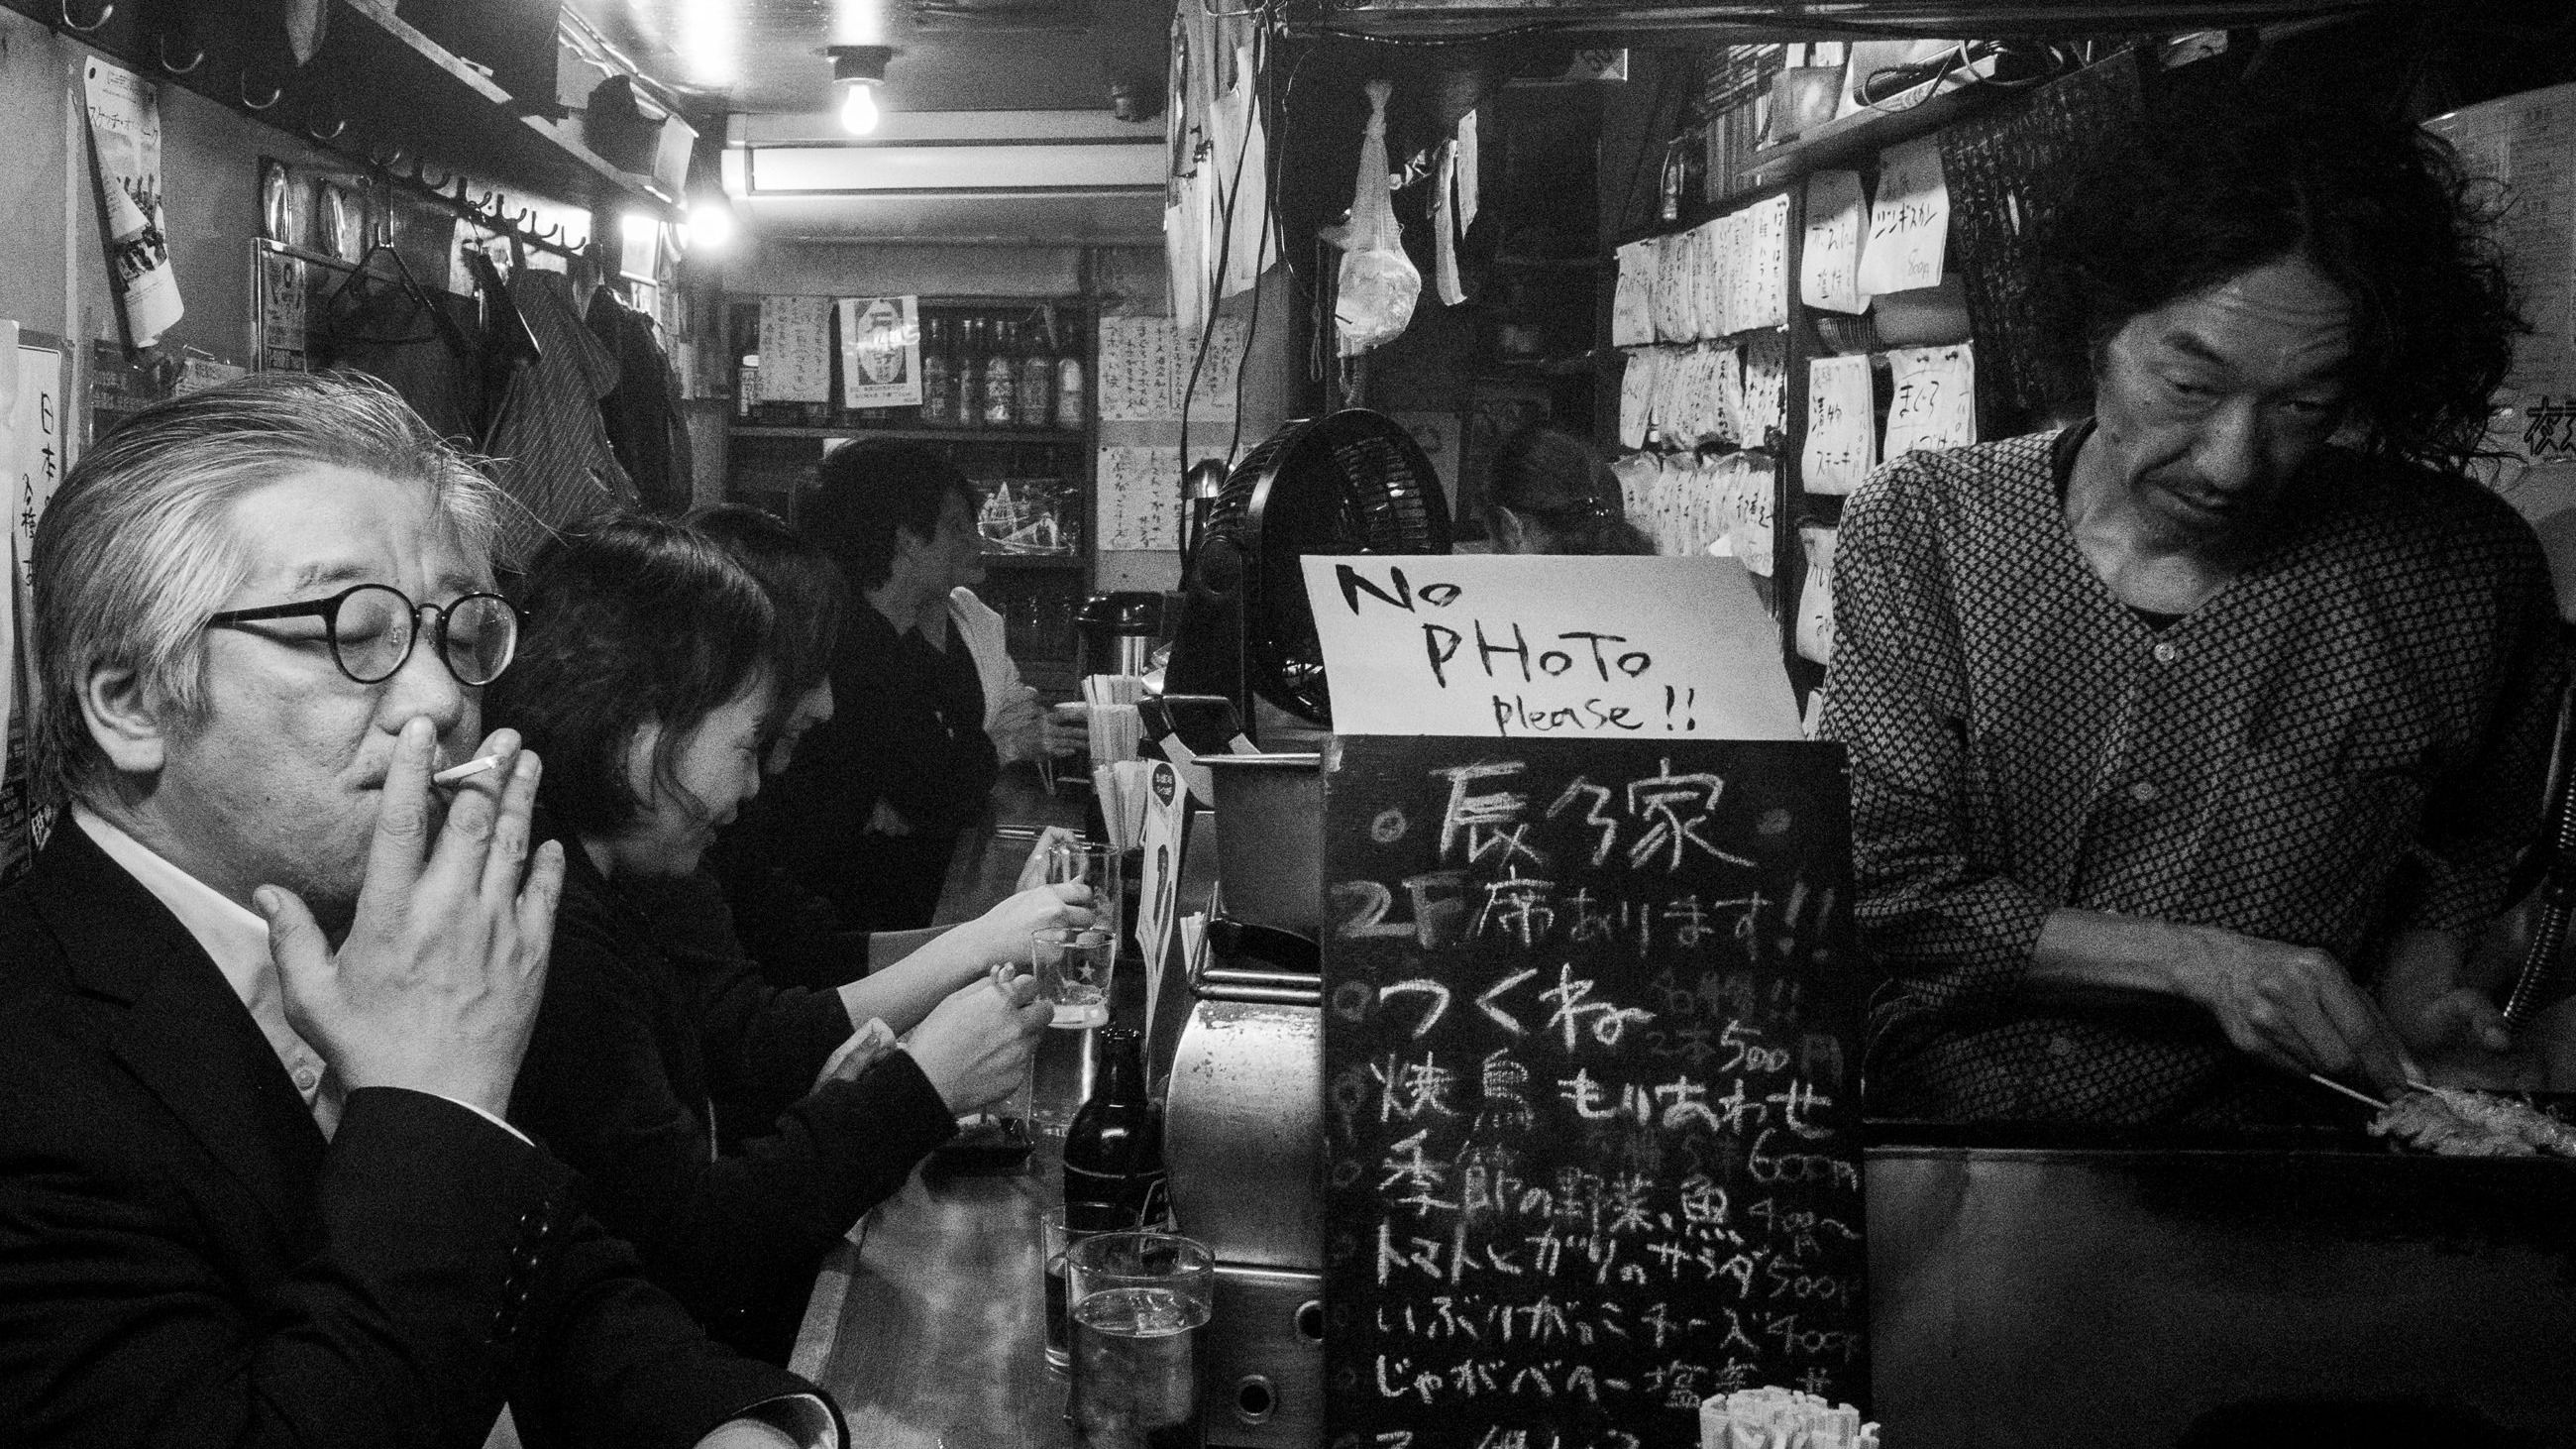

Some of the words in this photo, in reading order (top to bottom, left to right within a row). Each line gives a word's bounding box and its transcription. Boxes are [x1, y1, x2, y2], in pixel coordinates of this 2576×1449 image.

[1336, 564, 1462, 615] No
[1377, 962, 1657, 1053] つくね
